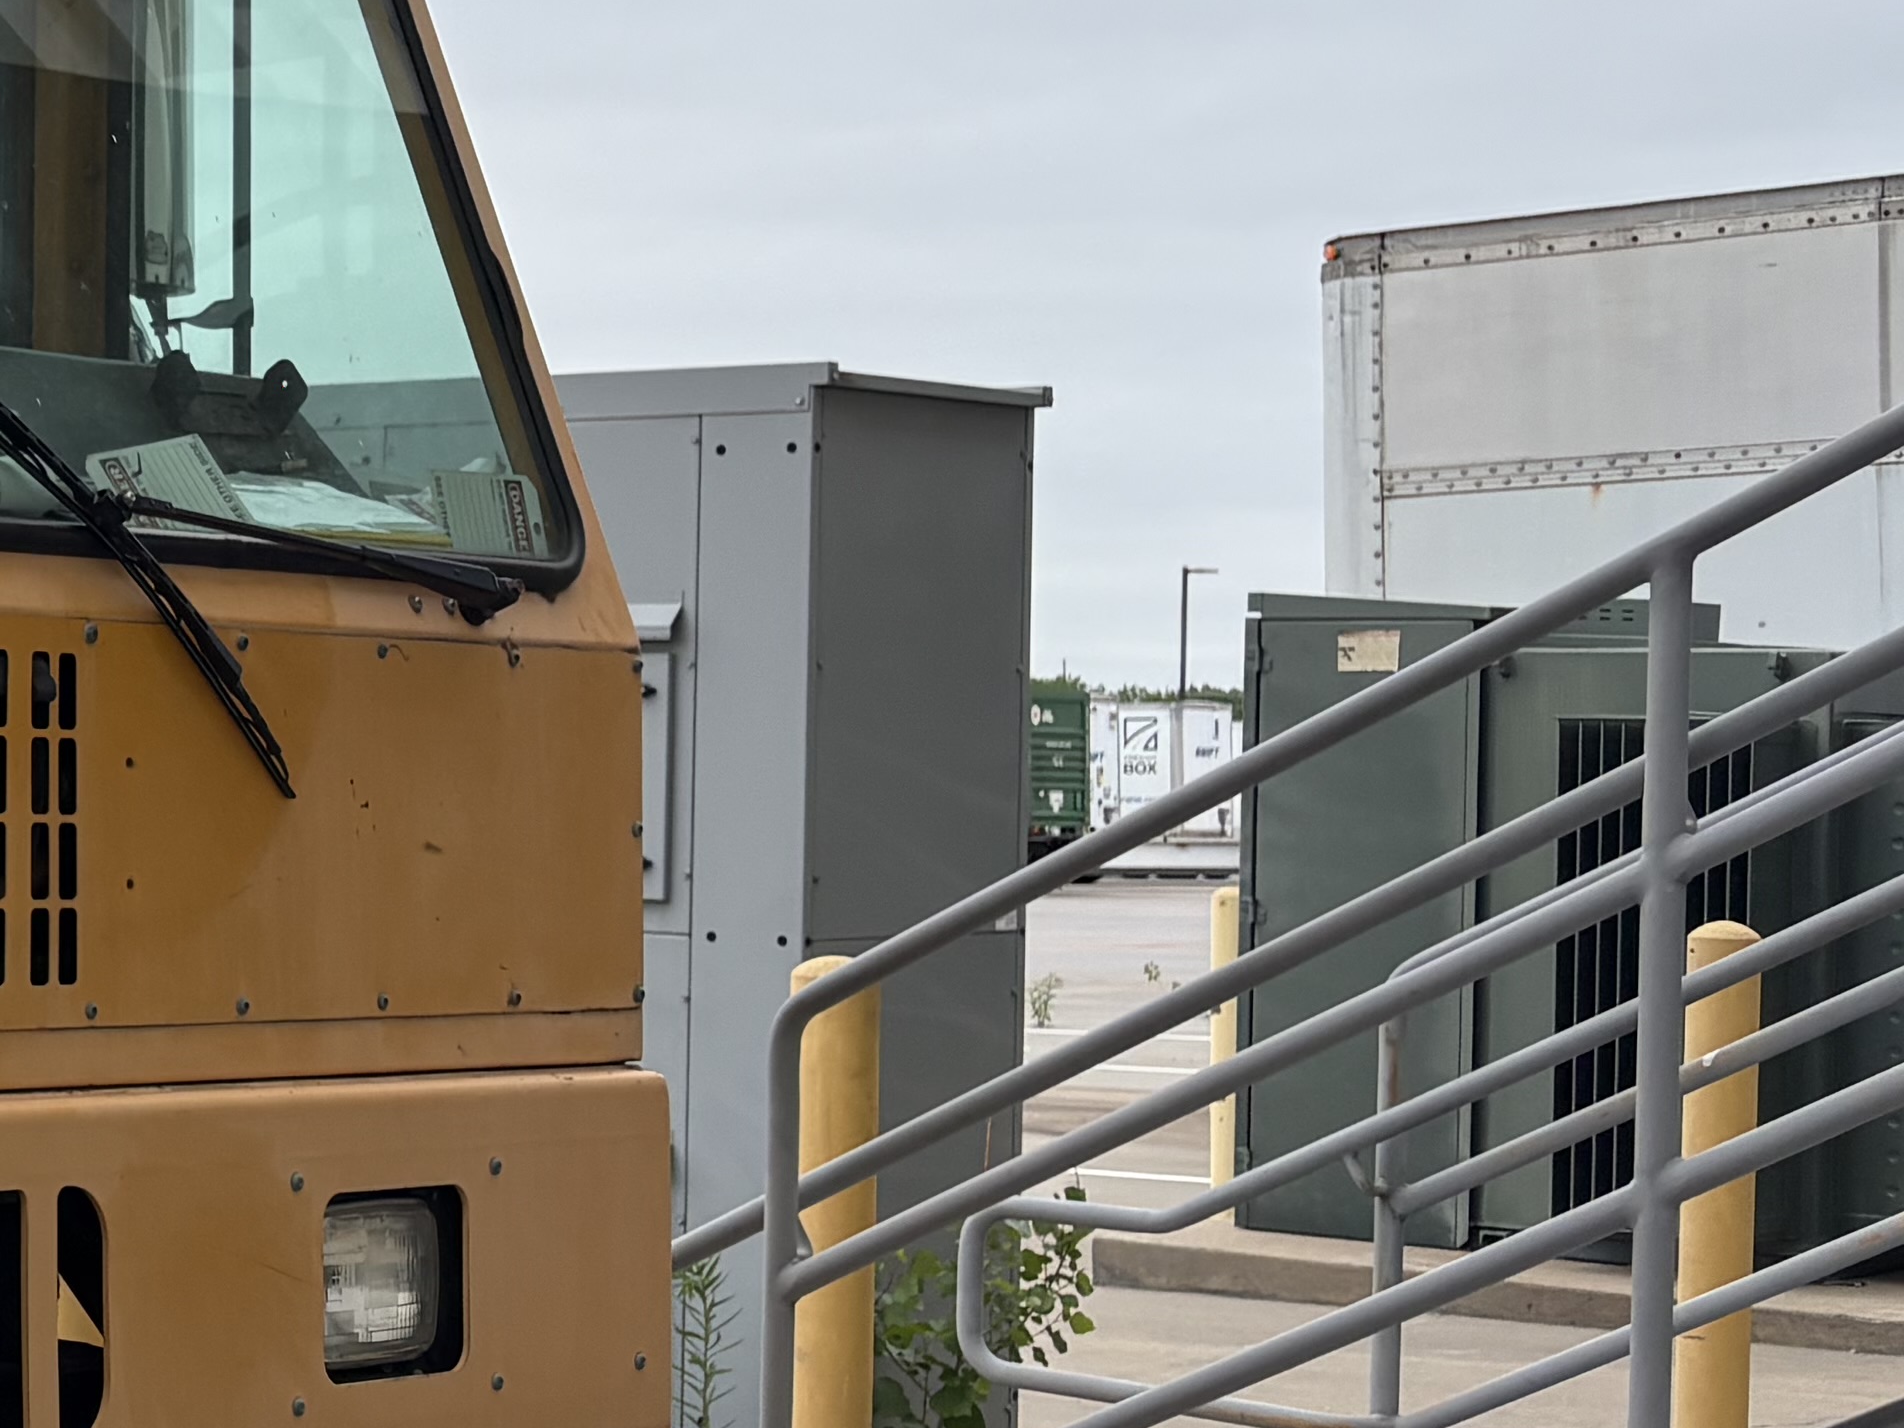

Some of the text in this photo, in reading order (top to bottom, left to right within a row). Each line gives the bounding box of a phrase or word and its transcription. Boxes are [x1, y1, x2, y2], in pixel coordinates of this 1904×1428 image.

[205, 466, 234, 505] OTHER
[508, 483, 530, 555] DANGE
[1123, 760, 1157, 776] BOX
